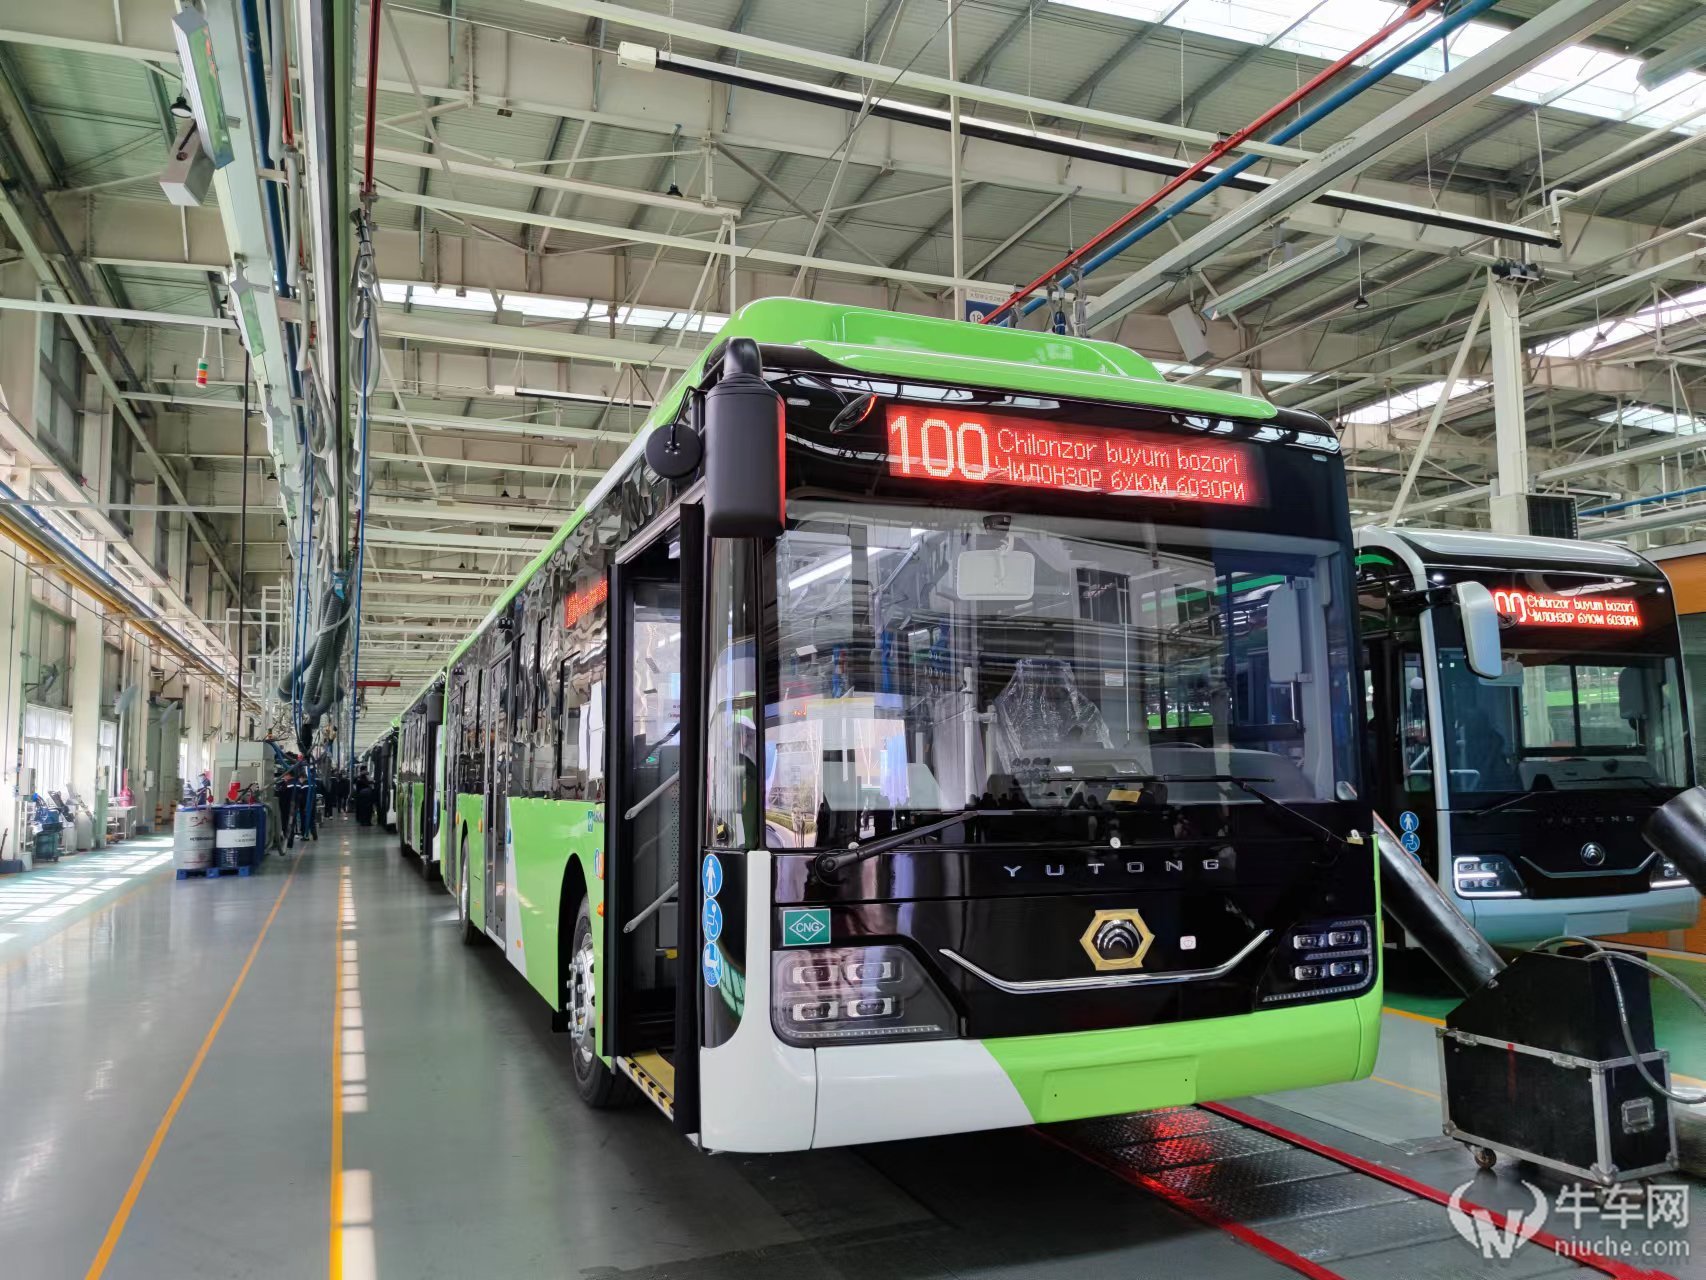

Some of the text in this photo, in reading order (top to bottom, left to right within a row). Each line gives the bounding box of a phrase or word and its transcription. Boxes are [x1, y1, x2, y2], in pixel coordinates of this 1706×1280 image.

[890, 415, 989, 480] 100
[998, 428, 1240, 475] Chilonzor buyum bozori
[1527, 594, 1635, 613] Chilonzor buyum bozori
[1003, 859, 1219, 877] YUTONG
[796, 921, 820, 933] CNG
